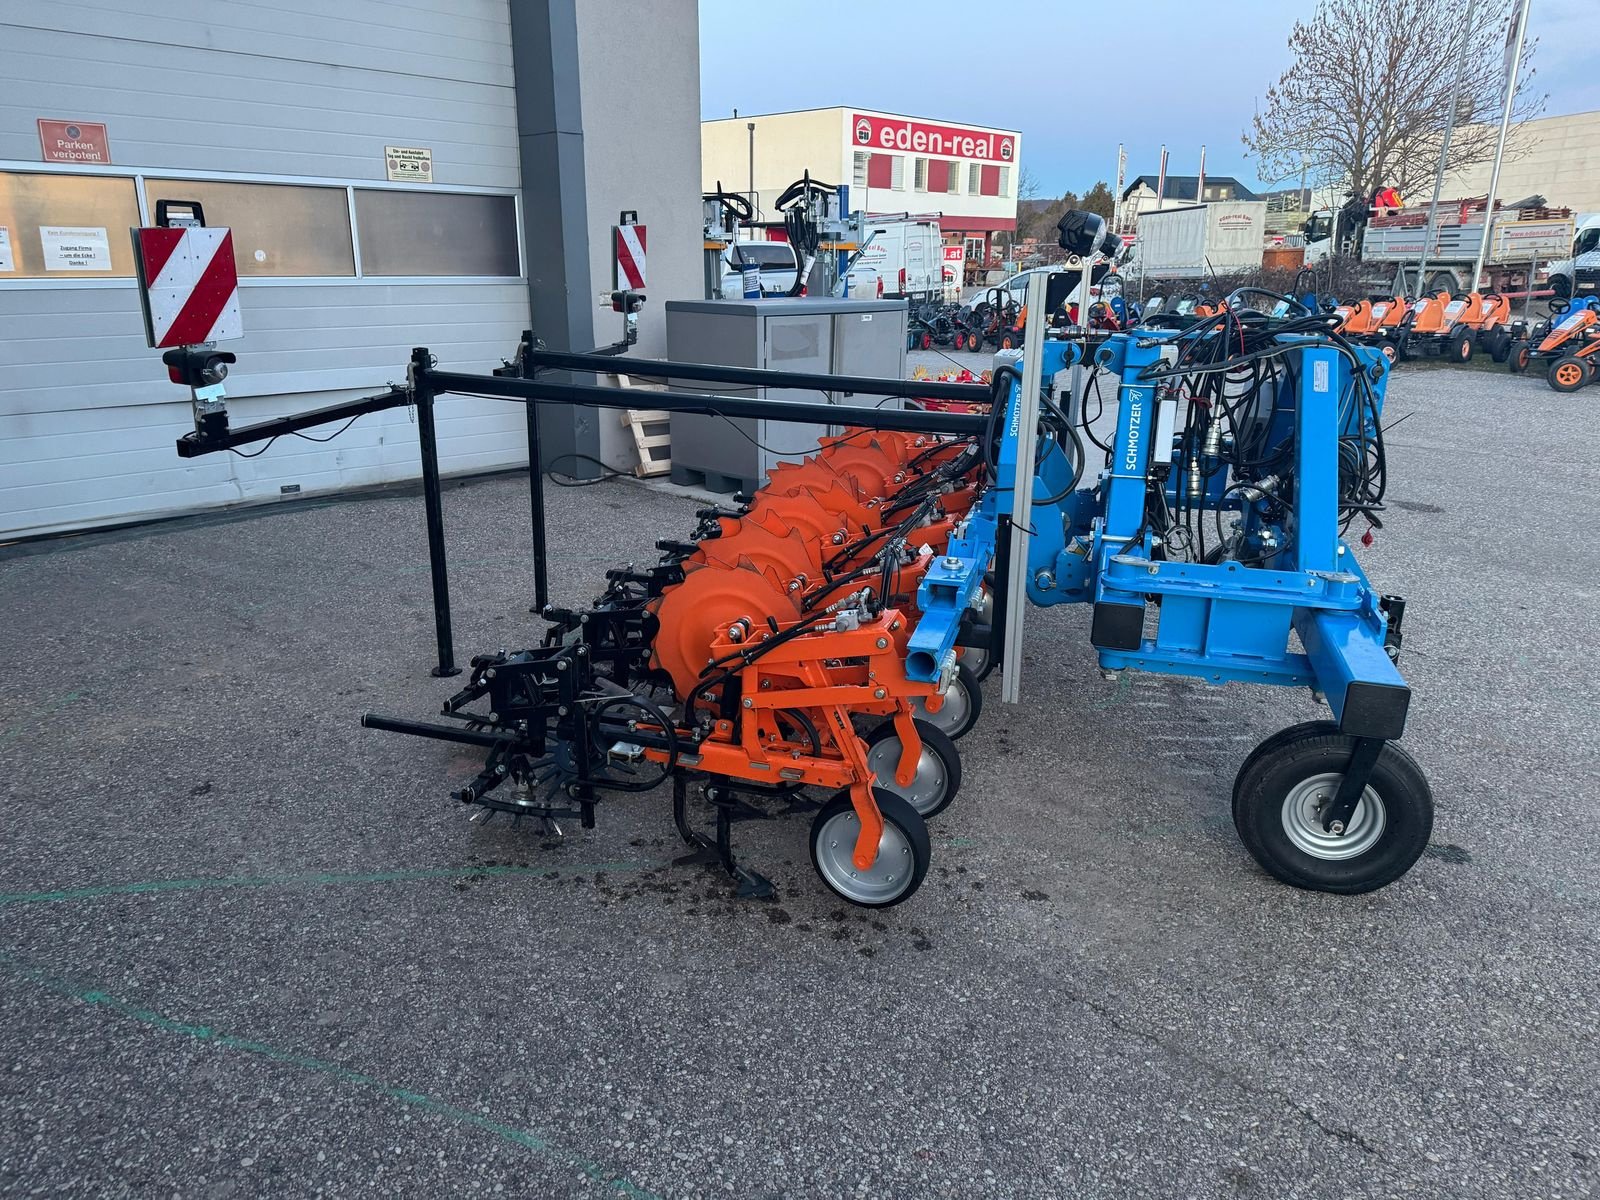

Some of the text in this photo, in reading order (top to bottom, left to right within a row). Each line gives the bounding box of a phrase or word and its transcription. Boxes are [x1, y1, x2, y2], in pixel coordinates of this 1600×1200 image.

[57, 140, 93, 150] Parken
[880, 123, 994, 158] eden-real
[53, 150, 101, 160] verboten!
[1126, 403, 1142, 470] SCHMOTZER
